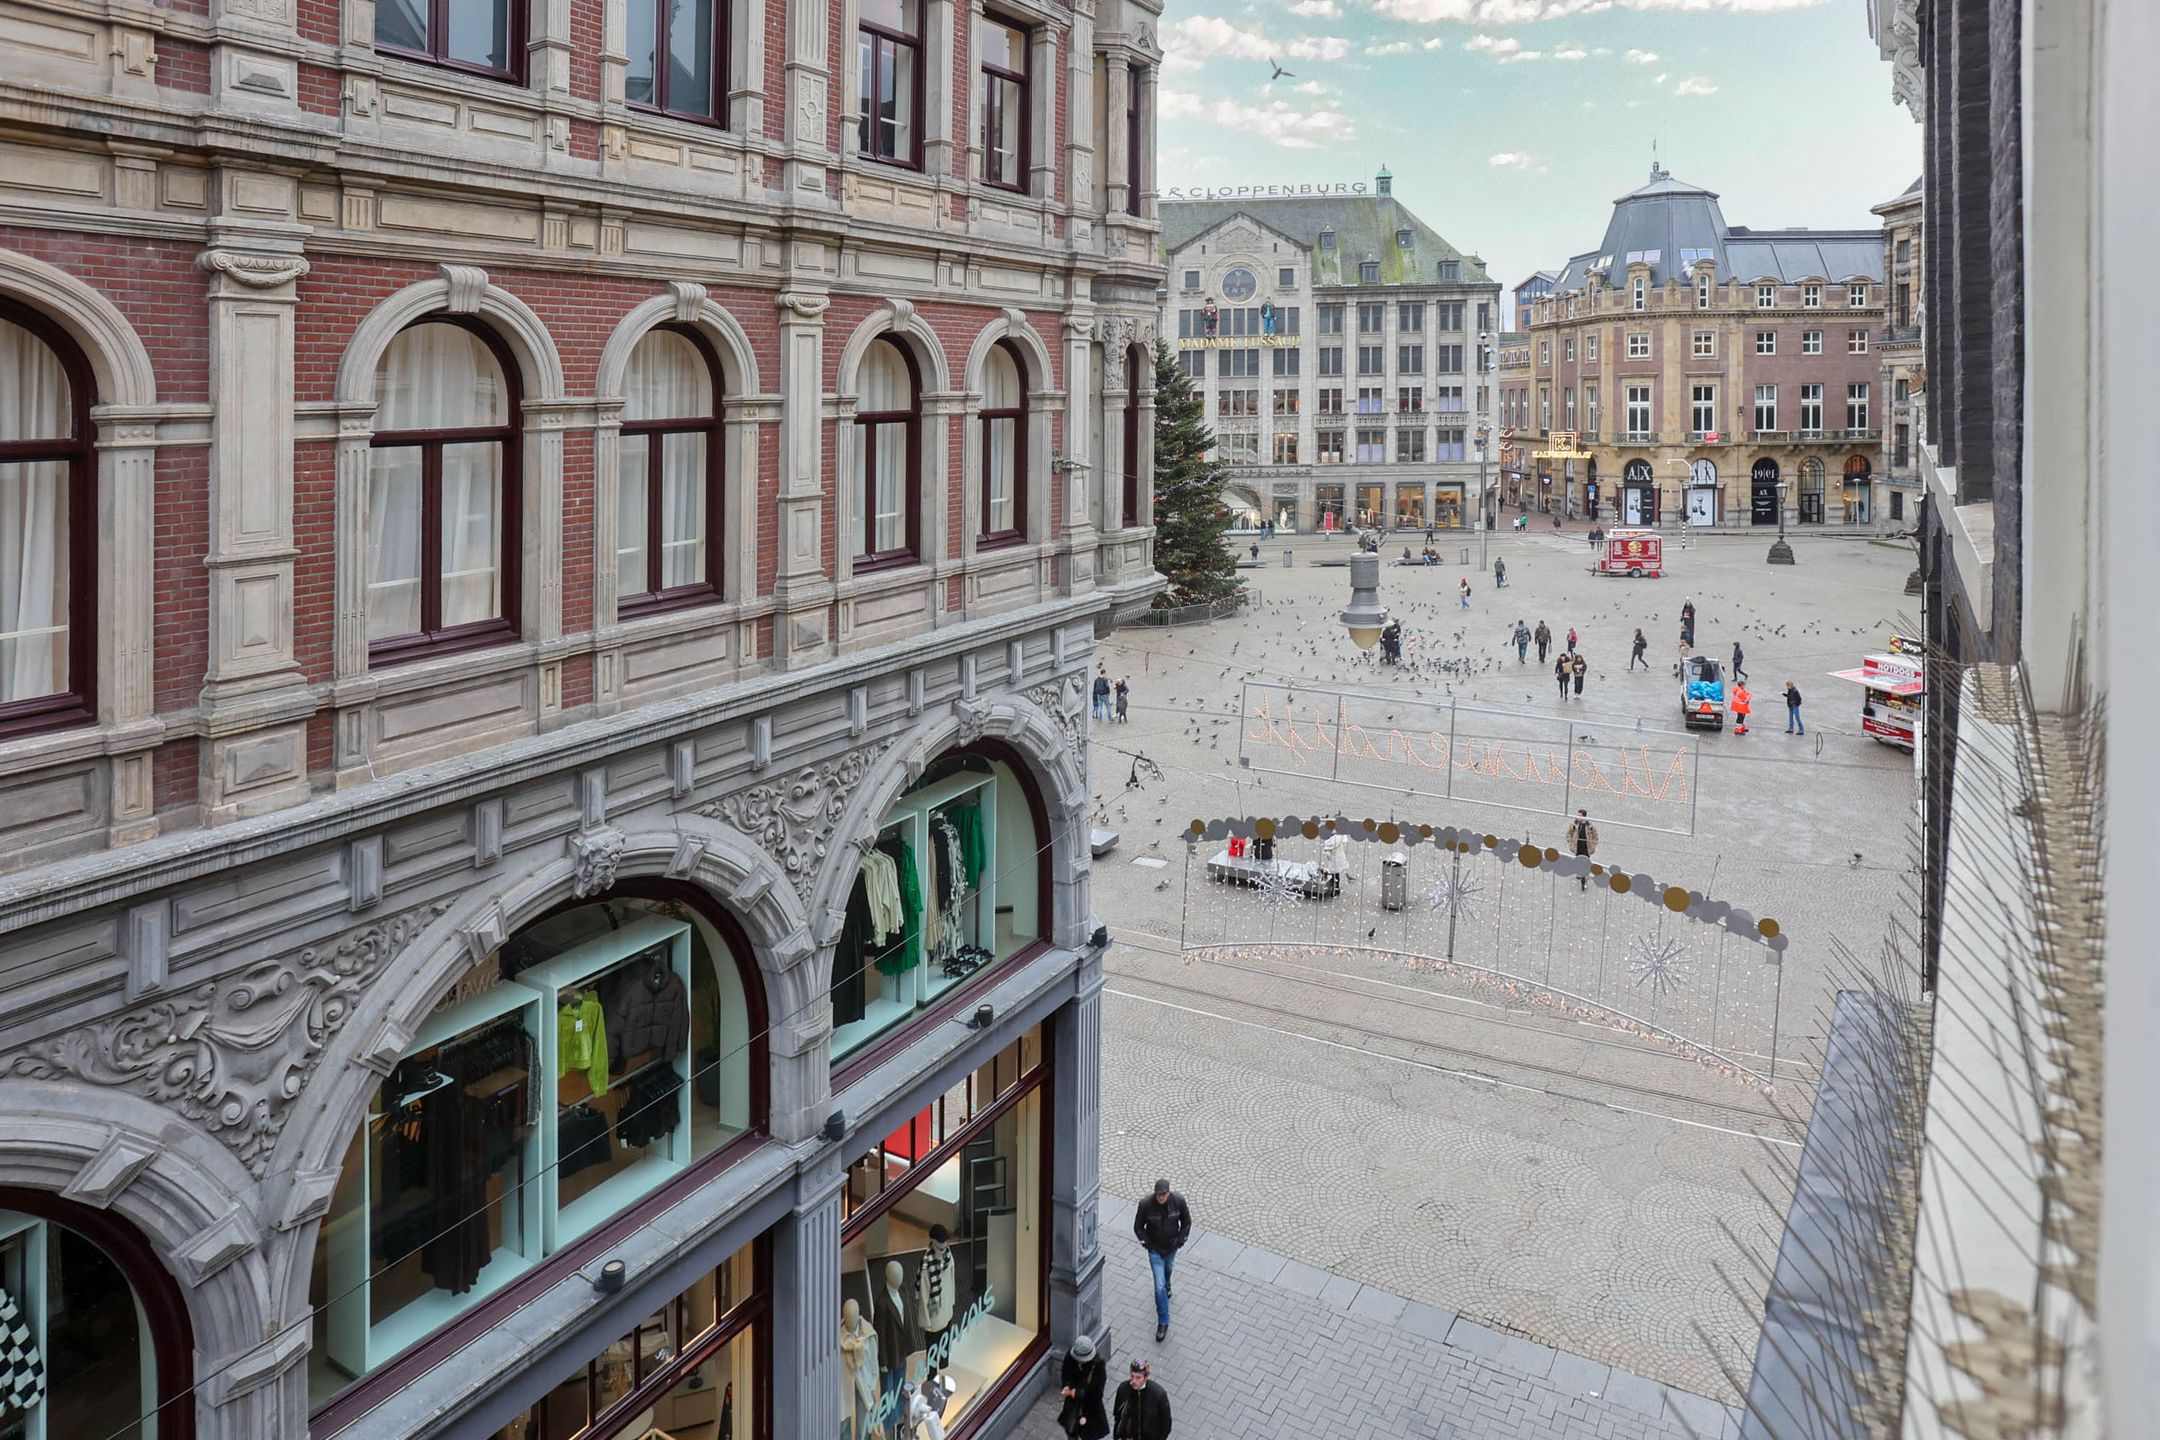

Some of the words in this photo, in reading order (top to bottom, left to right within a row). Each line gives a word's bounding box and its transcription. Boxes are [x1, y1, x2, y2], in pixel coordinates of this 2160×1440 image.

[1189, 182, 1367, 197] CLOPPENBURG
[1178, 337, 1236, 349] MADAME
[860, 1376, 904, 1440] NEW
[912, 1283, 996, 1383] ARRIVALS
